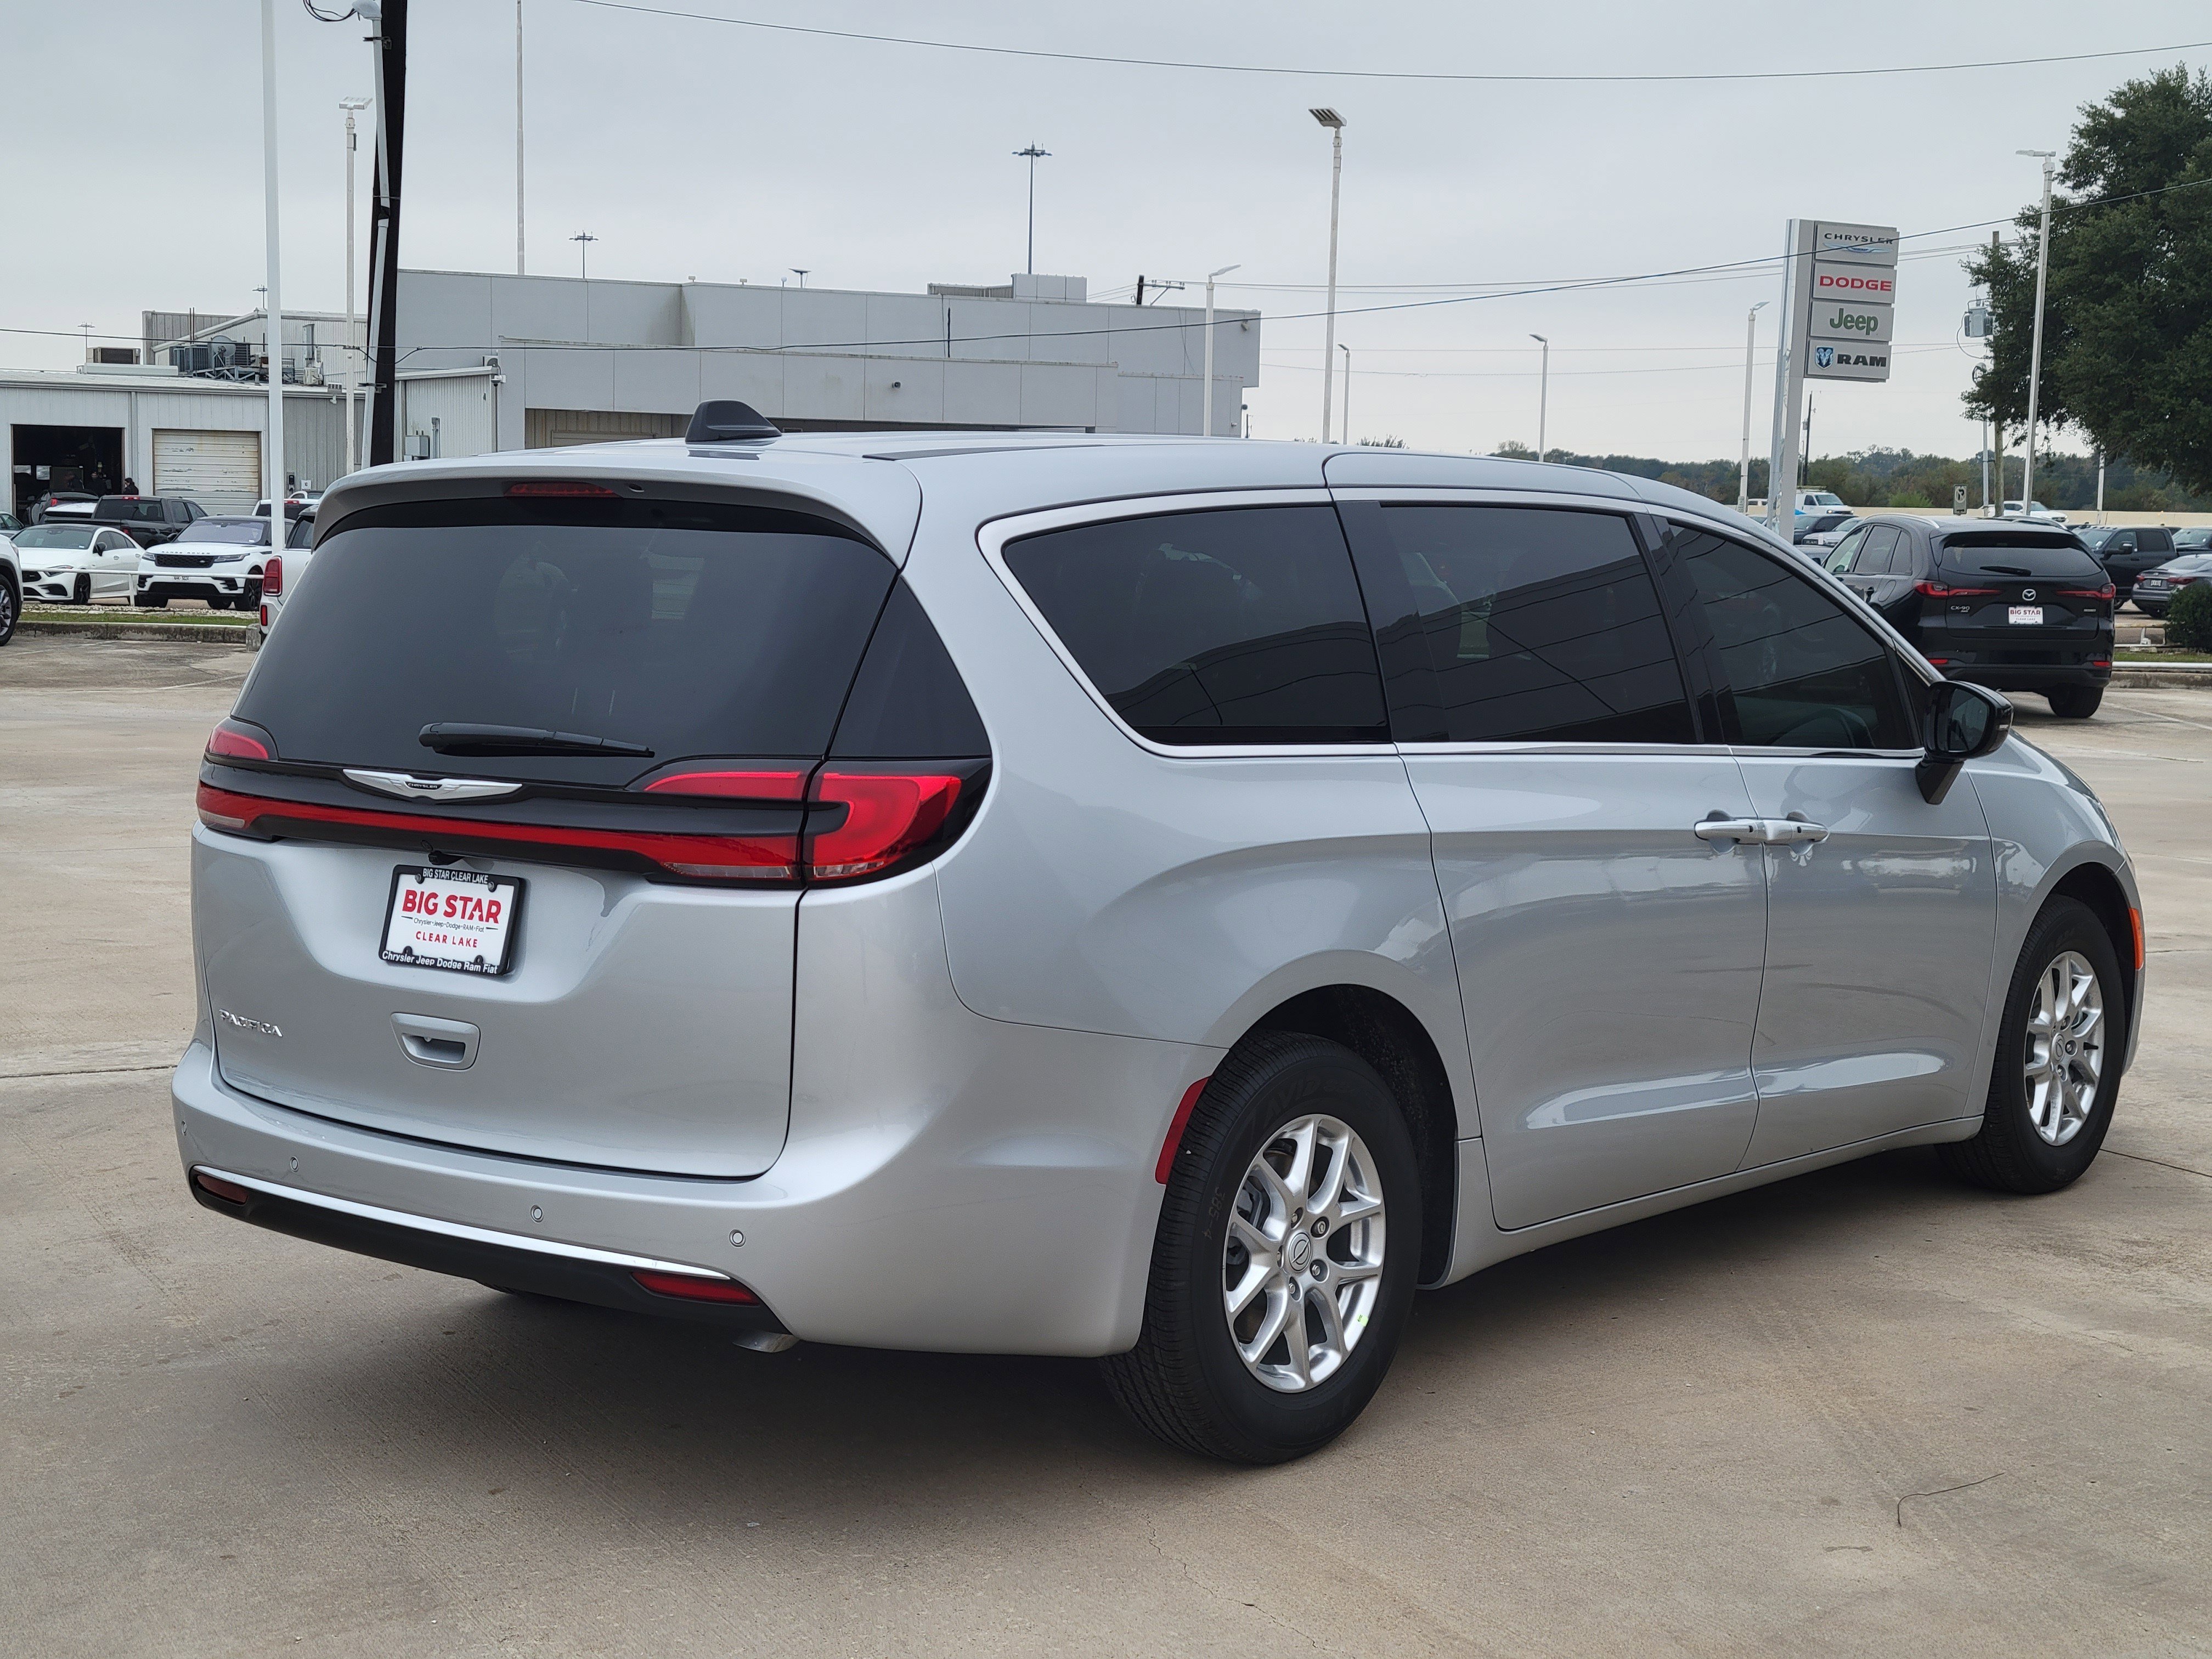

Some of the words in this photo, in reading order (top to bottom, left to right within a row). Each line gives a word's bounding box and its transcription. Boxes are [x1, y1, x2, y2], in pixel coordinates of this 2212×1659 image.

[1824, 233, 1893, 244] CHRYSLER
[1820, 275, 1892, 291] DODGE
[1830, 308, 1878, 335] Jeep
[1837, 354, 1886, 367] RAM
[423, 868, 433, 878] BIG
[434, 869, 450, 879] STAR
[451, 871, 471, 882] CLEAR
[472, 873, 488, 884] LAKE
[402, 889, 438, 915] BIG
[443, 895, 501, 924] STAR
[414, 917, 432, 926] Chrysler
[446, 922, 461, 930] Dodge
[415, 931, 447, 944] CLEAR
[452, 936, 478, 948] LAKE
[382, 950, 415, 963] Chrysler
[416, 955, 435, 966] Jeep
[437, 957, 461, 969] Dodge
[463, 961, 481, 972] Ram
[483, 963, 498, 974] Fiat
[219, 1008, 283, 1037] PACIFICA
